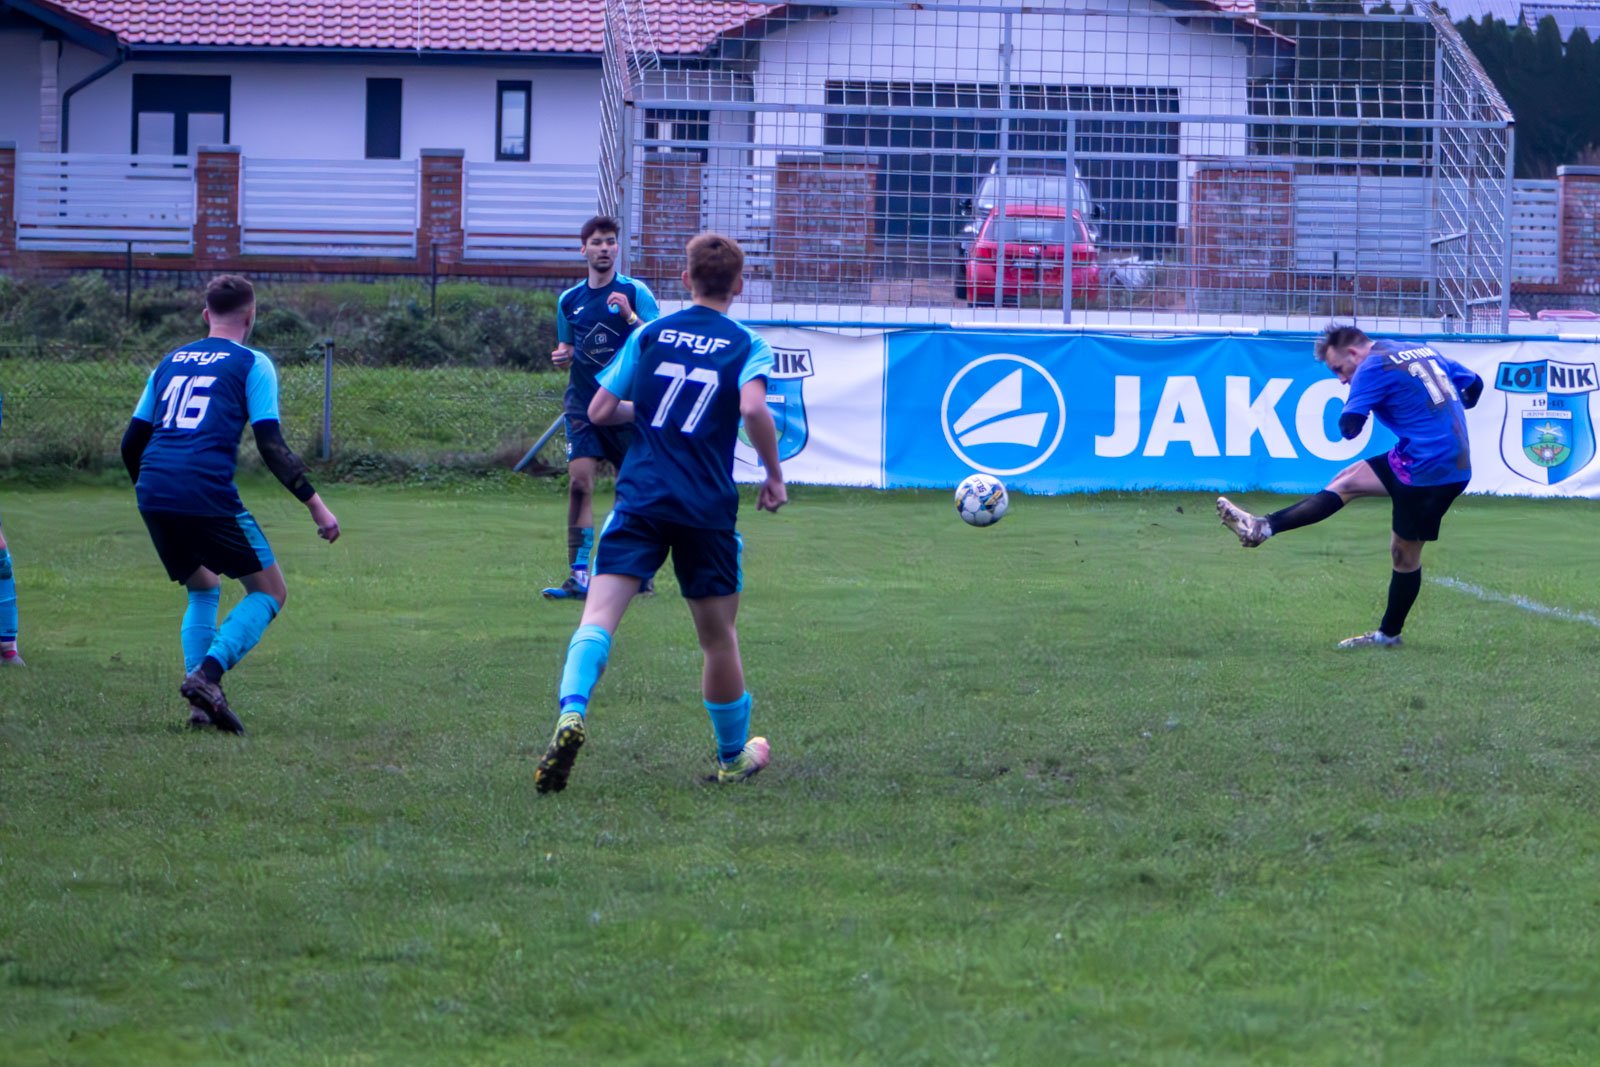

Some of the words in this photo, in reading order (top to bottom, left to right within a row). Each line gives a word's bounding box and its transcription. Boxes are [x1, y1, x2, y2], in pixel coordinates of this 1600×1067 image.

[172, 351, 230, 365] GRYF
[658, 329, 730, 354] GRYF
[1501, 365, 1594, 388] LOTNIK
[161, 375, 218, 429] 16
[651, 361, 719, 433] 77
[1095, 375, 1374, 461] JAKO
